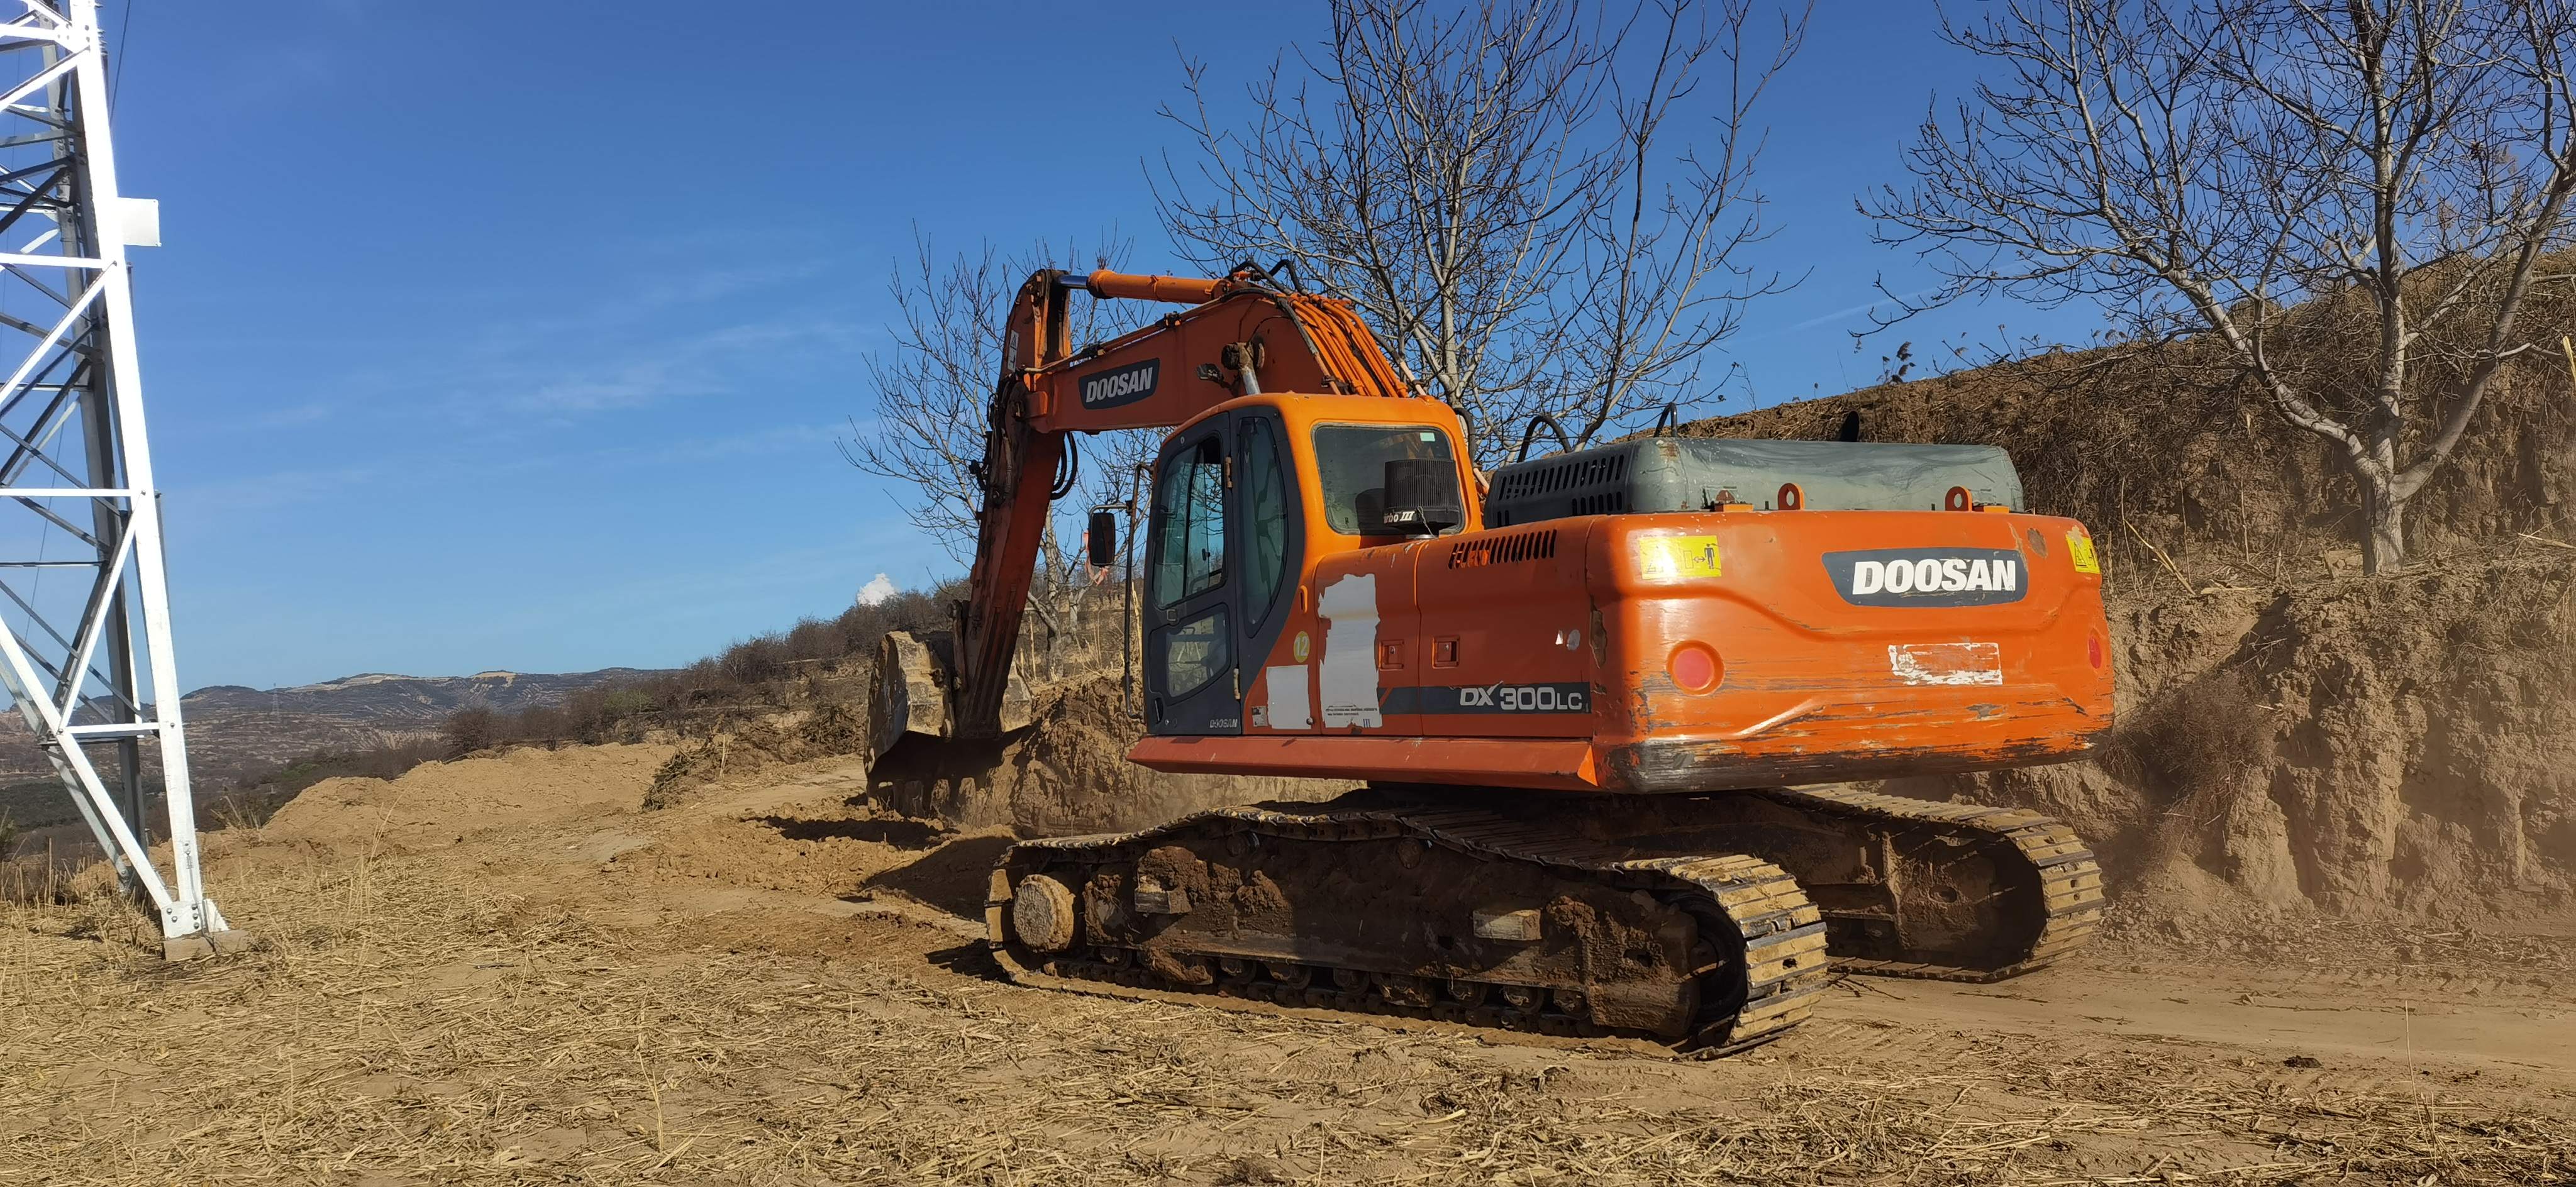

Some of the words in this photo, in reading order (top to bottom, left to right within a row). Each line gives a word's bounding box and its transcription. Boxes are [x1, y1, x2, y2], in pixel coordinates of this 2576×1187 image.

[1085, 367, 1153, 403] DOOSAN
[1852, 558, 2016, 595] DOOSAN
[1296, 636, 1309, 656] 12
